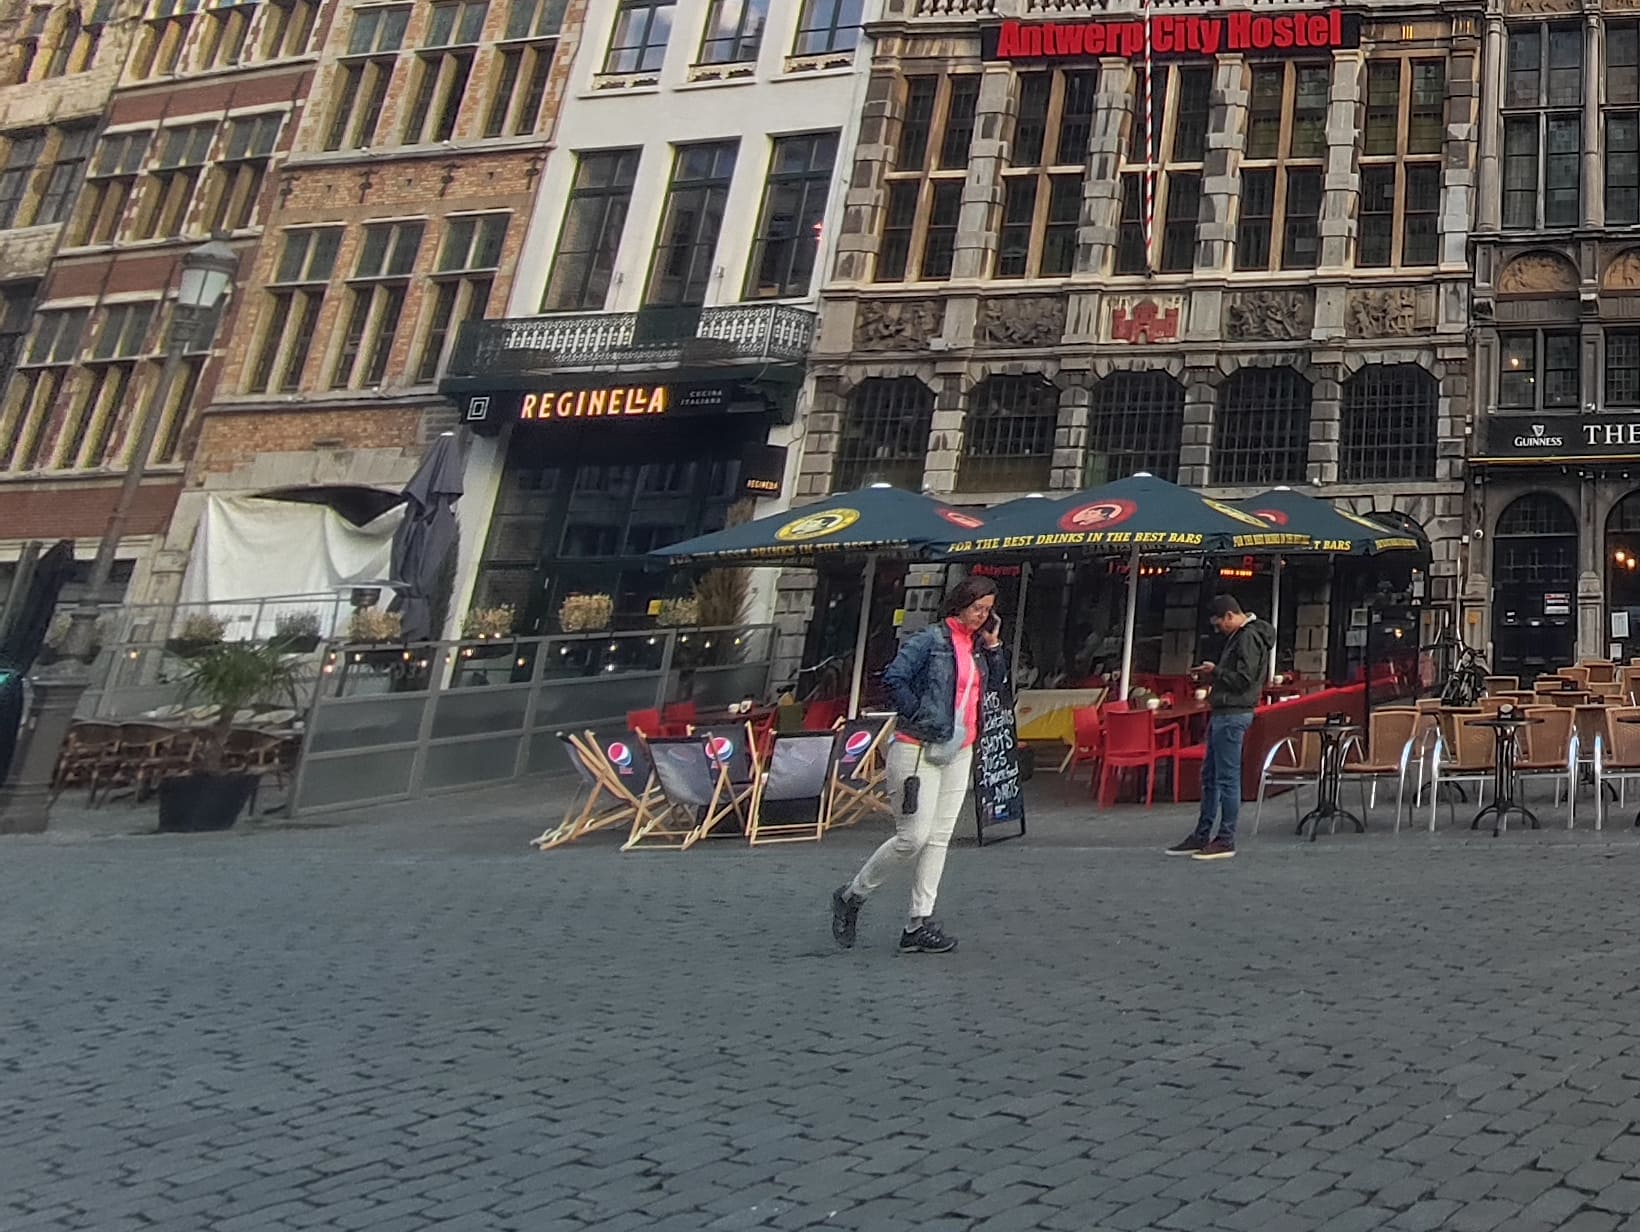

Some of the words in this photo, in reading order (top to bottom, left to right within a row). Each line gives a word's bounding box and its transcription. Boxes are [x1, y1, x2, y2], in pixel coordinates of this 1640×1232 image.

[997, 21, 1144, 58] Antwerp
[1152, 15, 1222, 54] City
[1228, 9, 1342, 48] Hostel
[521, 387, 667, 418] REGINELLA
[1514, 436, 1563, 447] GUINNESS
[948, 541, 972, 553] FOR
[975, 537, 1000, 550] THE
[1002, 534, 1034, 548] BEST
[1035, 532, 1084, 545] DRINKS
[1087, 532, 1103, 543] IN
[1106, 532, 1132, 544] THE
[1134, 532, 1165, 544] BEST
[1168, 532, 1203, 545] BARS
[1323, 540, 1352, 551] BARS
